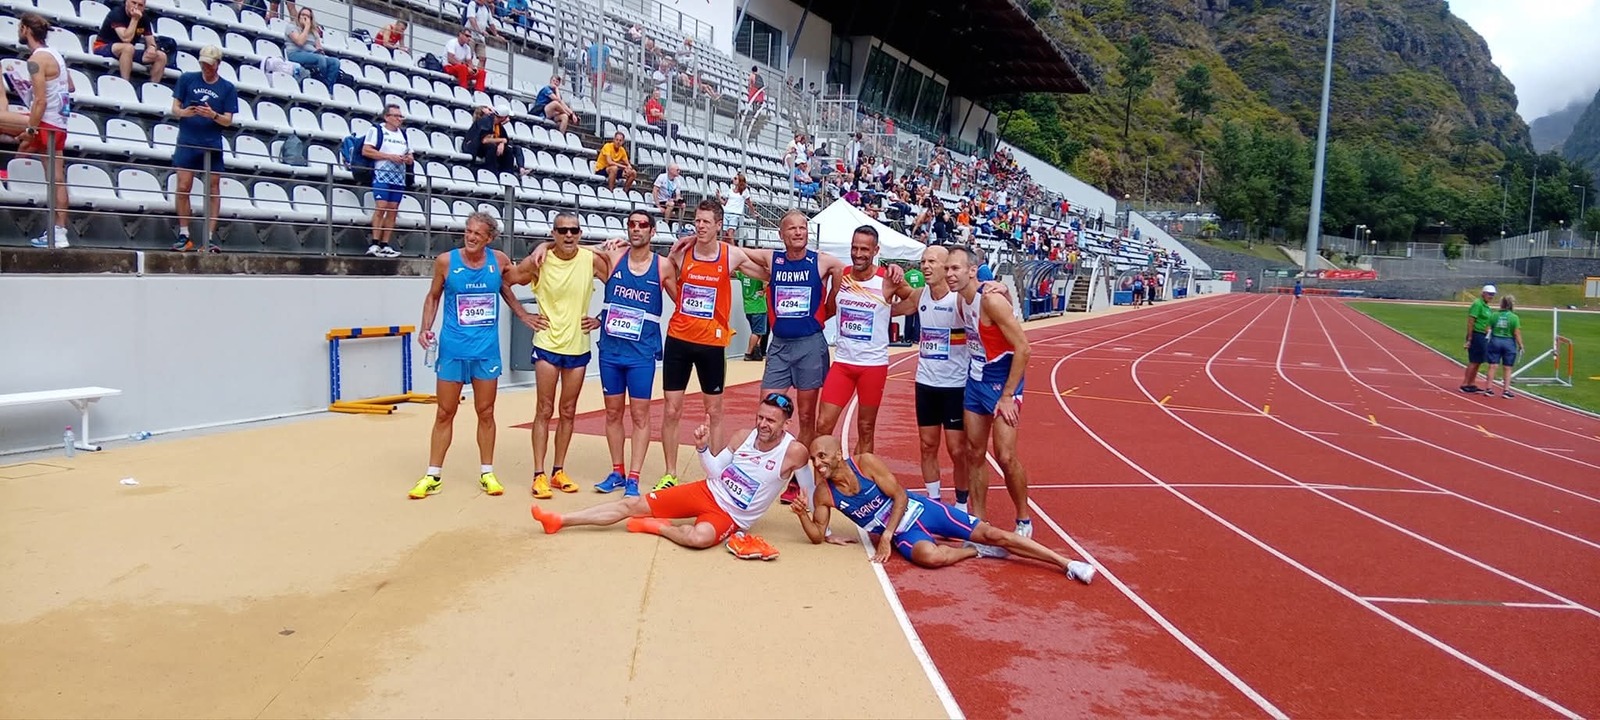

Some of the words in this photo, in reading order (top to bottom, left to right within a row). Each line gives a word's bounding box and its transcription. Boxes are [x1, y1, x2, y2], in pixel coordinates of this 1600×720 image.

[687, 273, 720, 282] nederland
[775, 270, 810, 282] NORWAY
[613, 285, 651, 303] FRANCE
[686, 298, 703, 308] 4231
[780, 300, 799, 308] 4294
[839, 298, 877, 309] ESPAÑA
[465, 308, 485, 317] 3940
[612, 318, 631, 329] 2120
[845, 322, 862, 331] 1696
[724, 479, 743, 496] 4333
